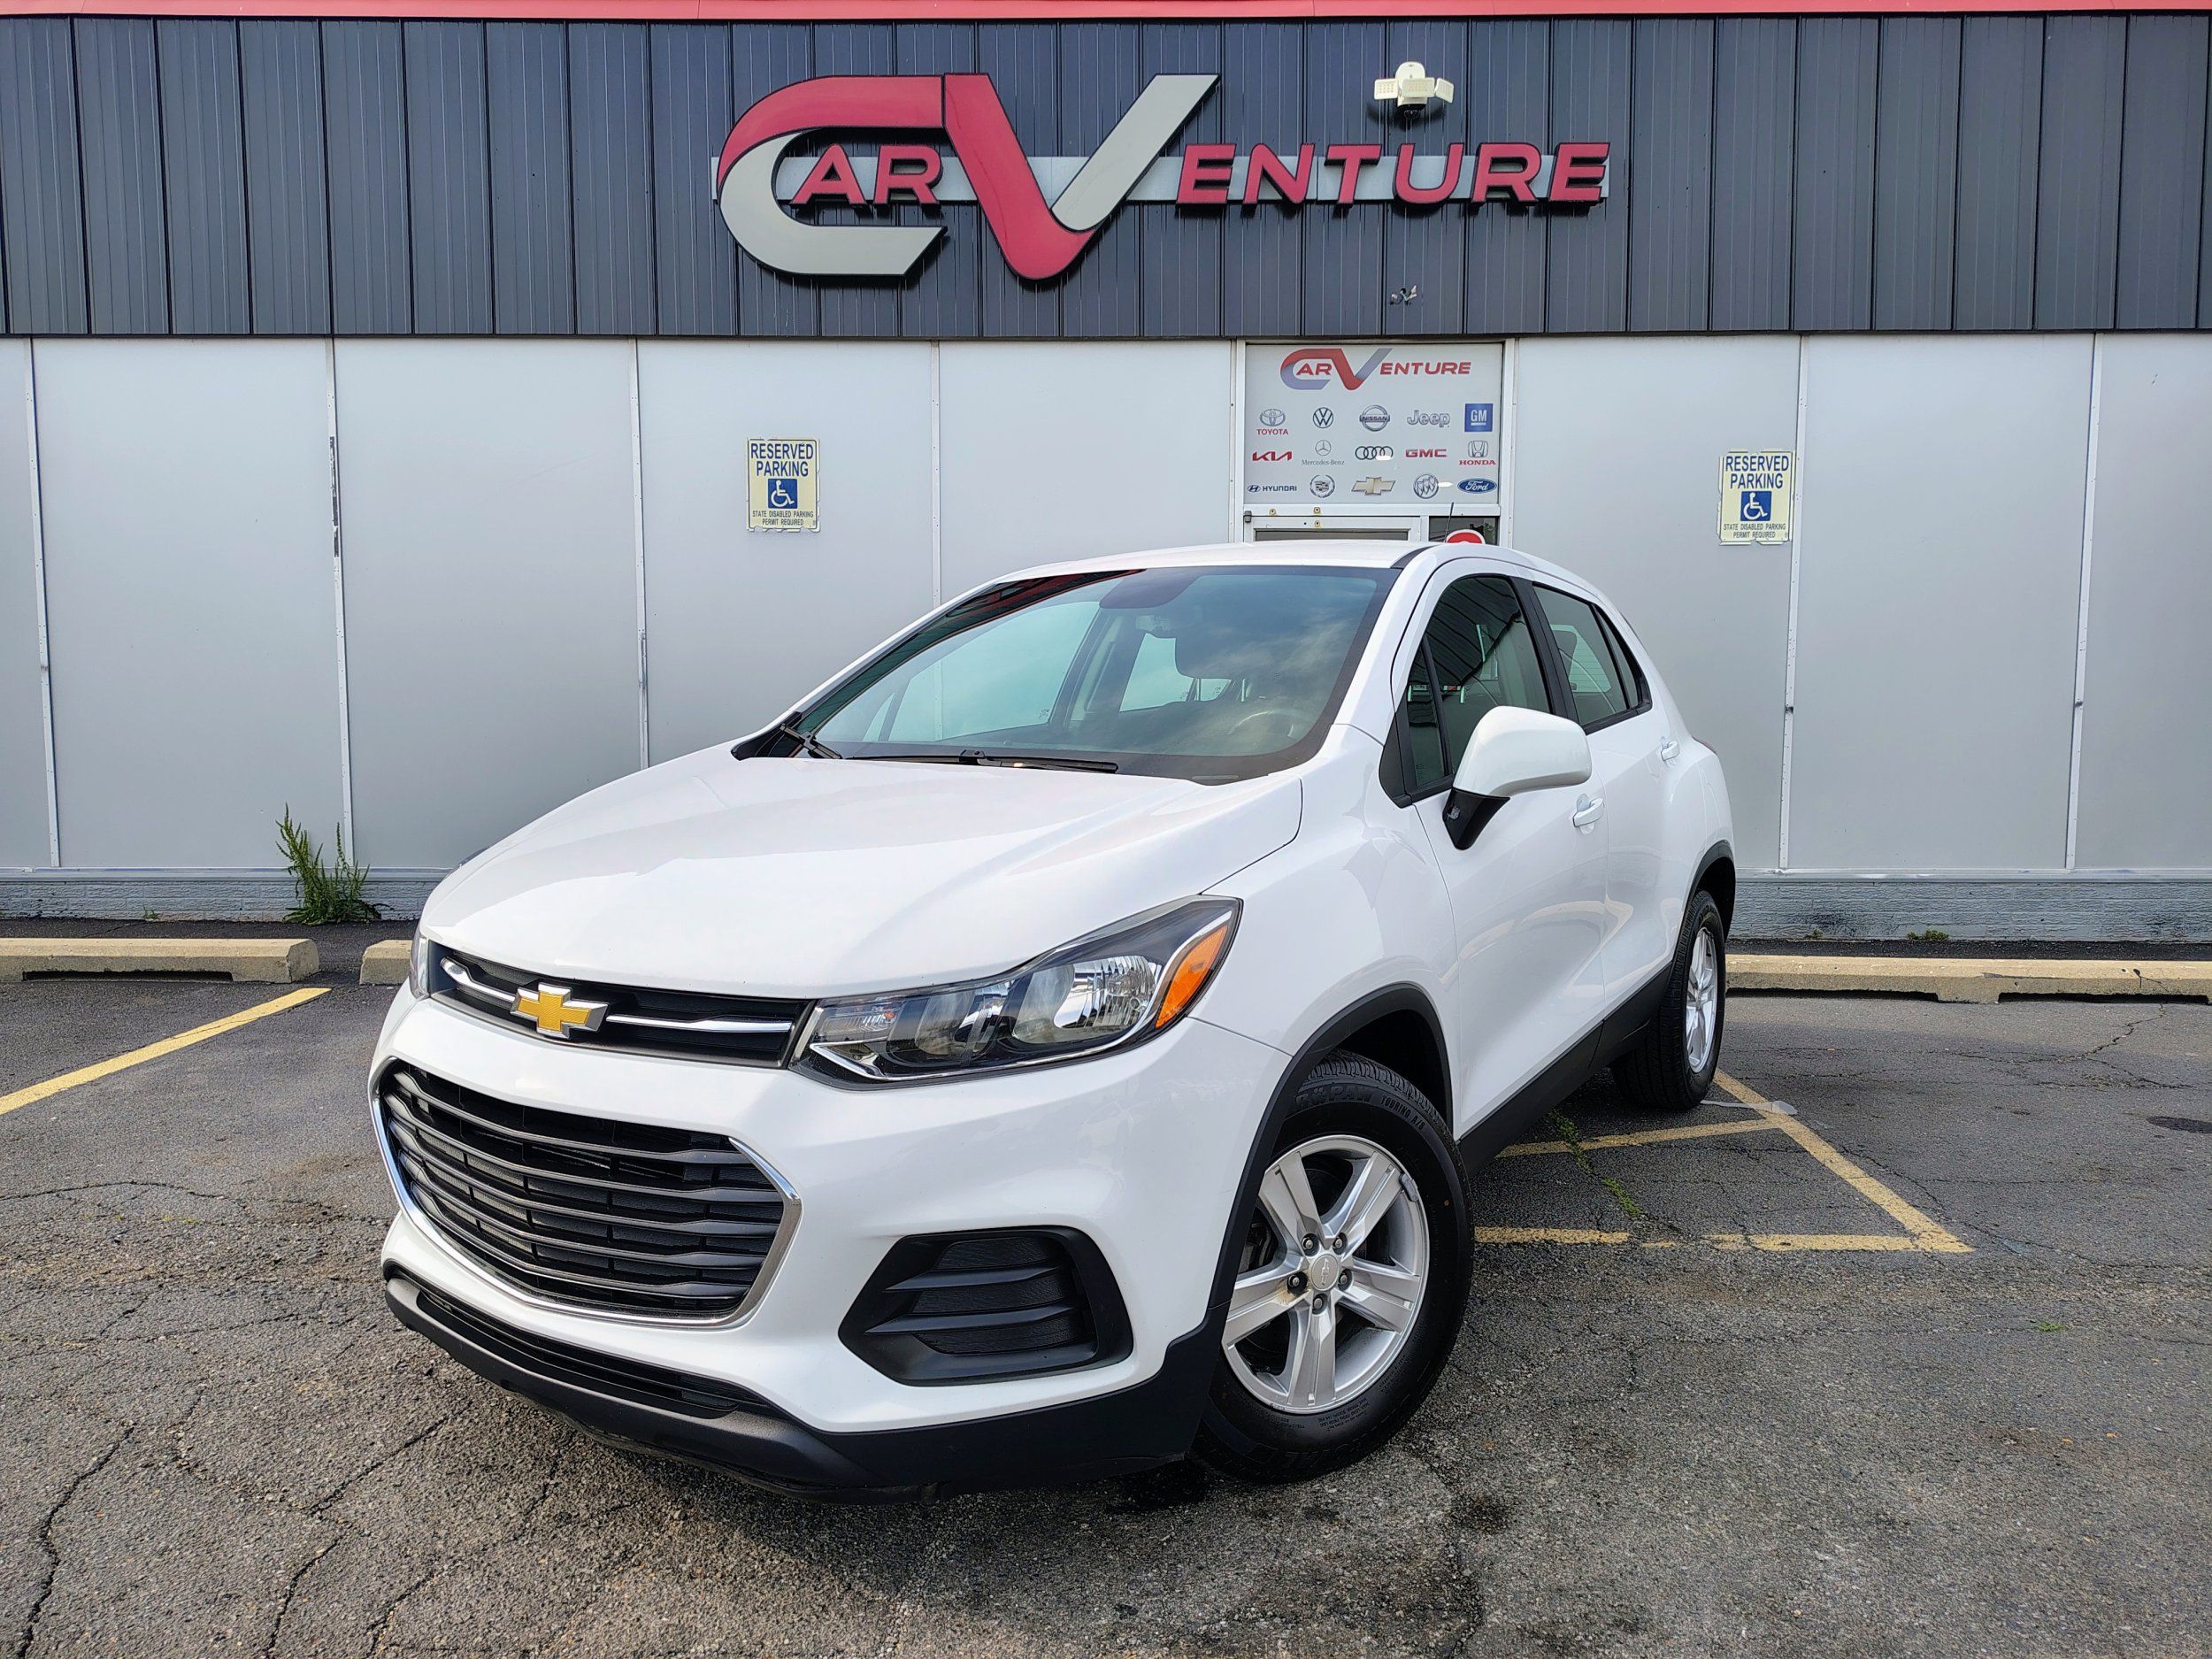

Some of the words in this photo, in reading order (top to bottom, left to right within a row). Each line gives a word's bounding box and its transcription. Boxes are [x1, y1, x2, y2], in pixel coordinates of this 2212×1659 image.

[1407, 410, 1450, 427] Jeep
[1471, 409, 1487, 422] GM
[750, 443, 814, 459] RESERVED
[1405, 449, 1447, 457] GMC
[757, 461, 809, 476] PARKING
[1725, 456, 1789, 472] RESERVED
[1465, 479, 1488, 491] Ford
[1730, 472, 1783, 488] PARKING
